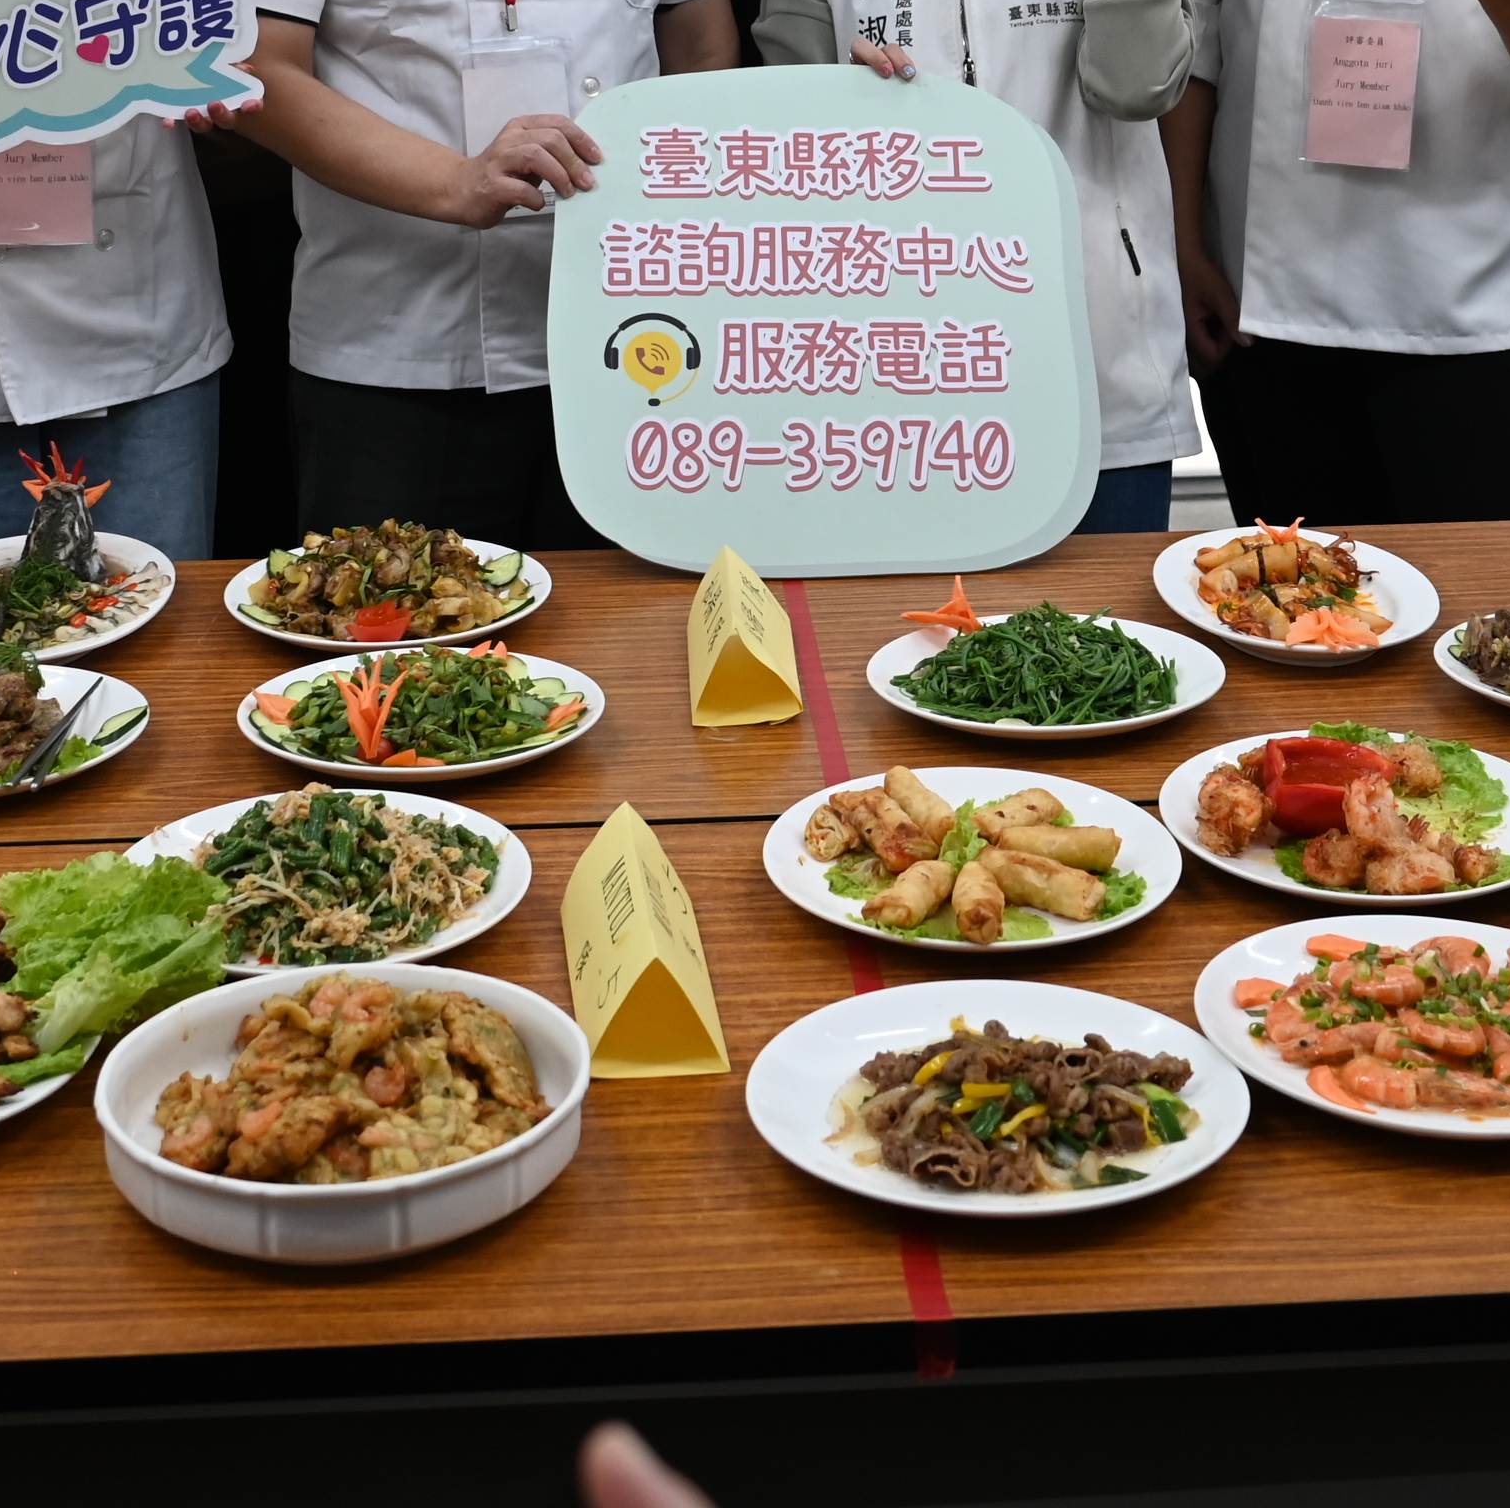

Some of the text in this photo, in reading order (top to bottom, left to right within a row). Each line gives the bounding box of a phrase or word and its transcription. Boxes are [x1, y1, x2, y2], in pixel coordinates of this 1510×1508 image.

[1008, 0, 1084, 21] 臺東縣政
[1335, 79, 1391, 91] Jury Member
[4, 153, 64, 164] Jury Member
[642, 127, 993, 200] 臺東縣移工
[603, 223, 1033, 294] 諮詢服務中心
[716, 320, 1011, 393] 服務電話
[627, 418, 1015, 491] 089-359740
[601, 855, 634, 945] MANTUL
